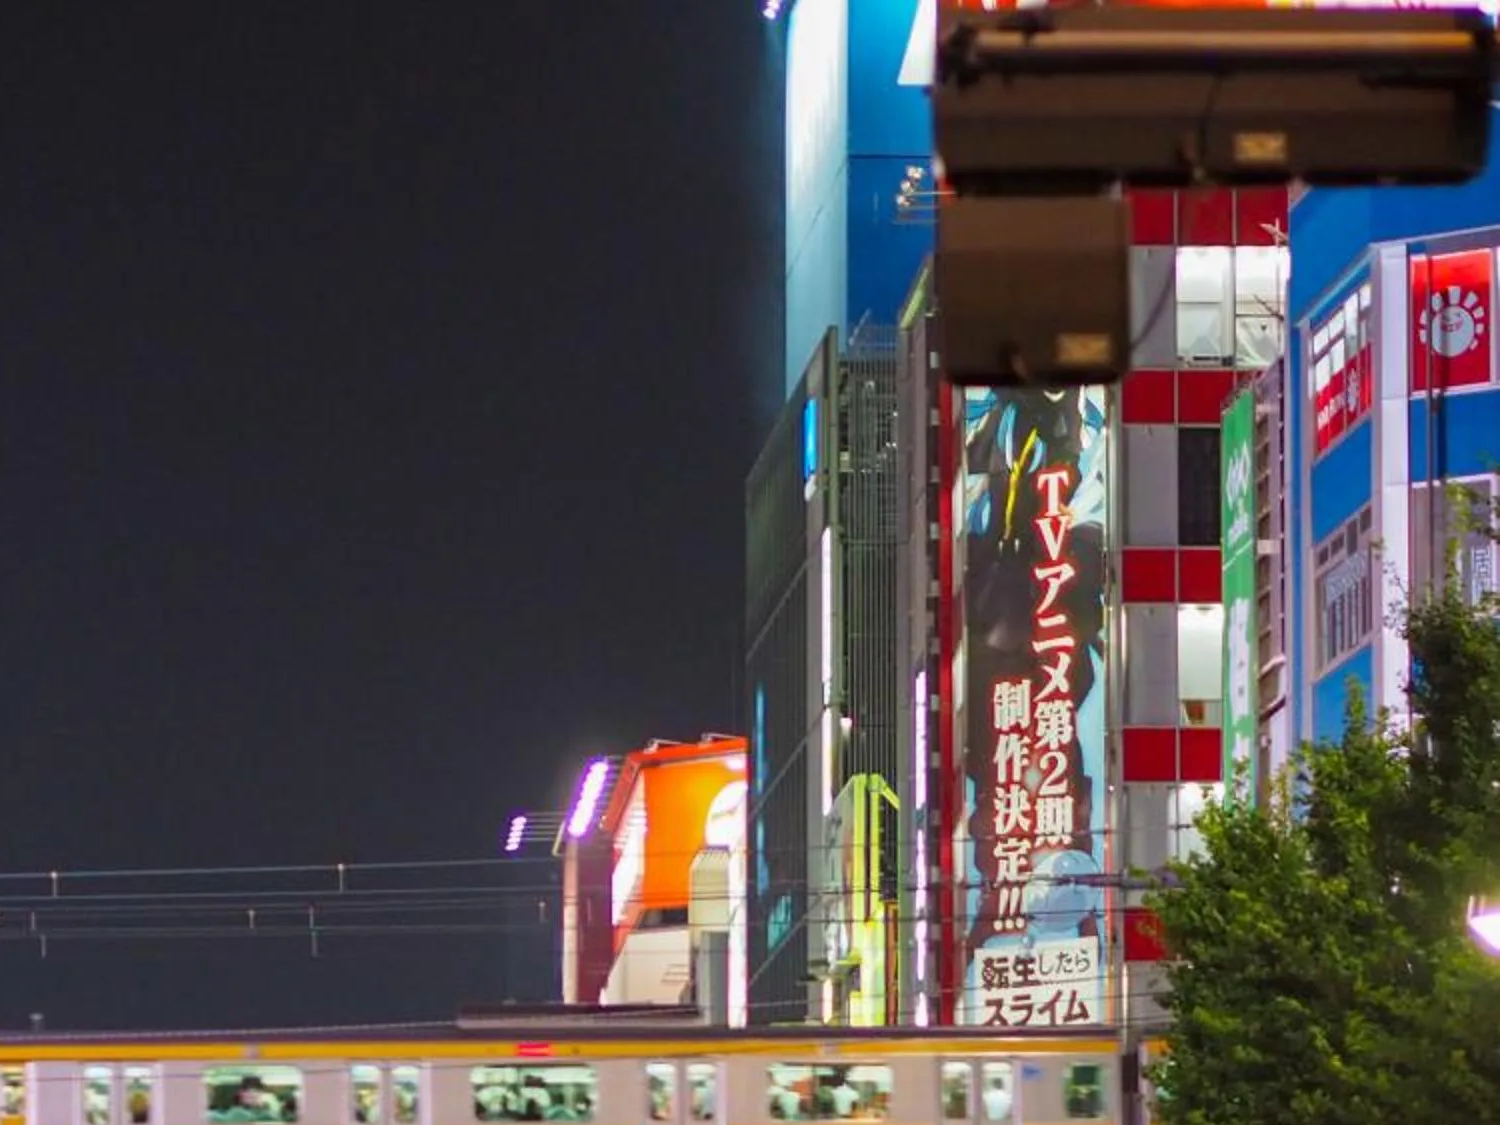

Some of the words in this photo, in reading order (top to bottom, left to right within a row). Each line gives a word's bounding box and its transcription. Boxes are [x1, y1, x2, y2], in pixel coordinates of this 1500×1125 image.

[1032, 470, 1075, 846] TVアニメ第2期
[993, 679, 1031, 931] 制作決定!!!
[981, 948, 1092, 991] 転生したら
[985, 990, 1090, 1025] スライム
